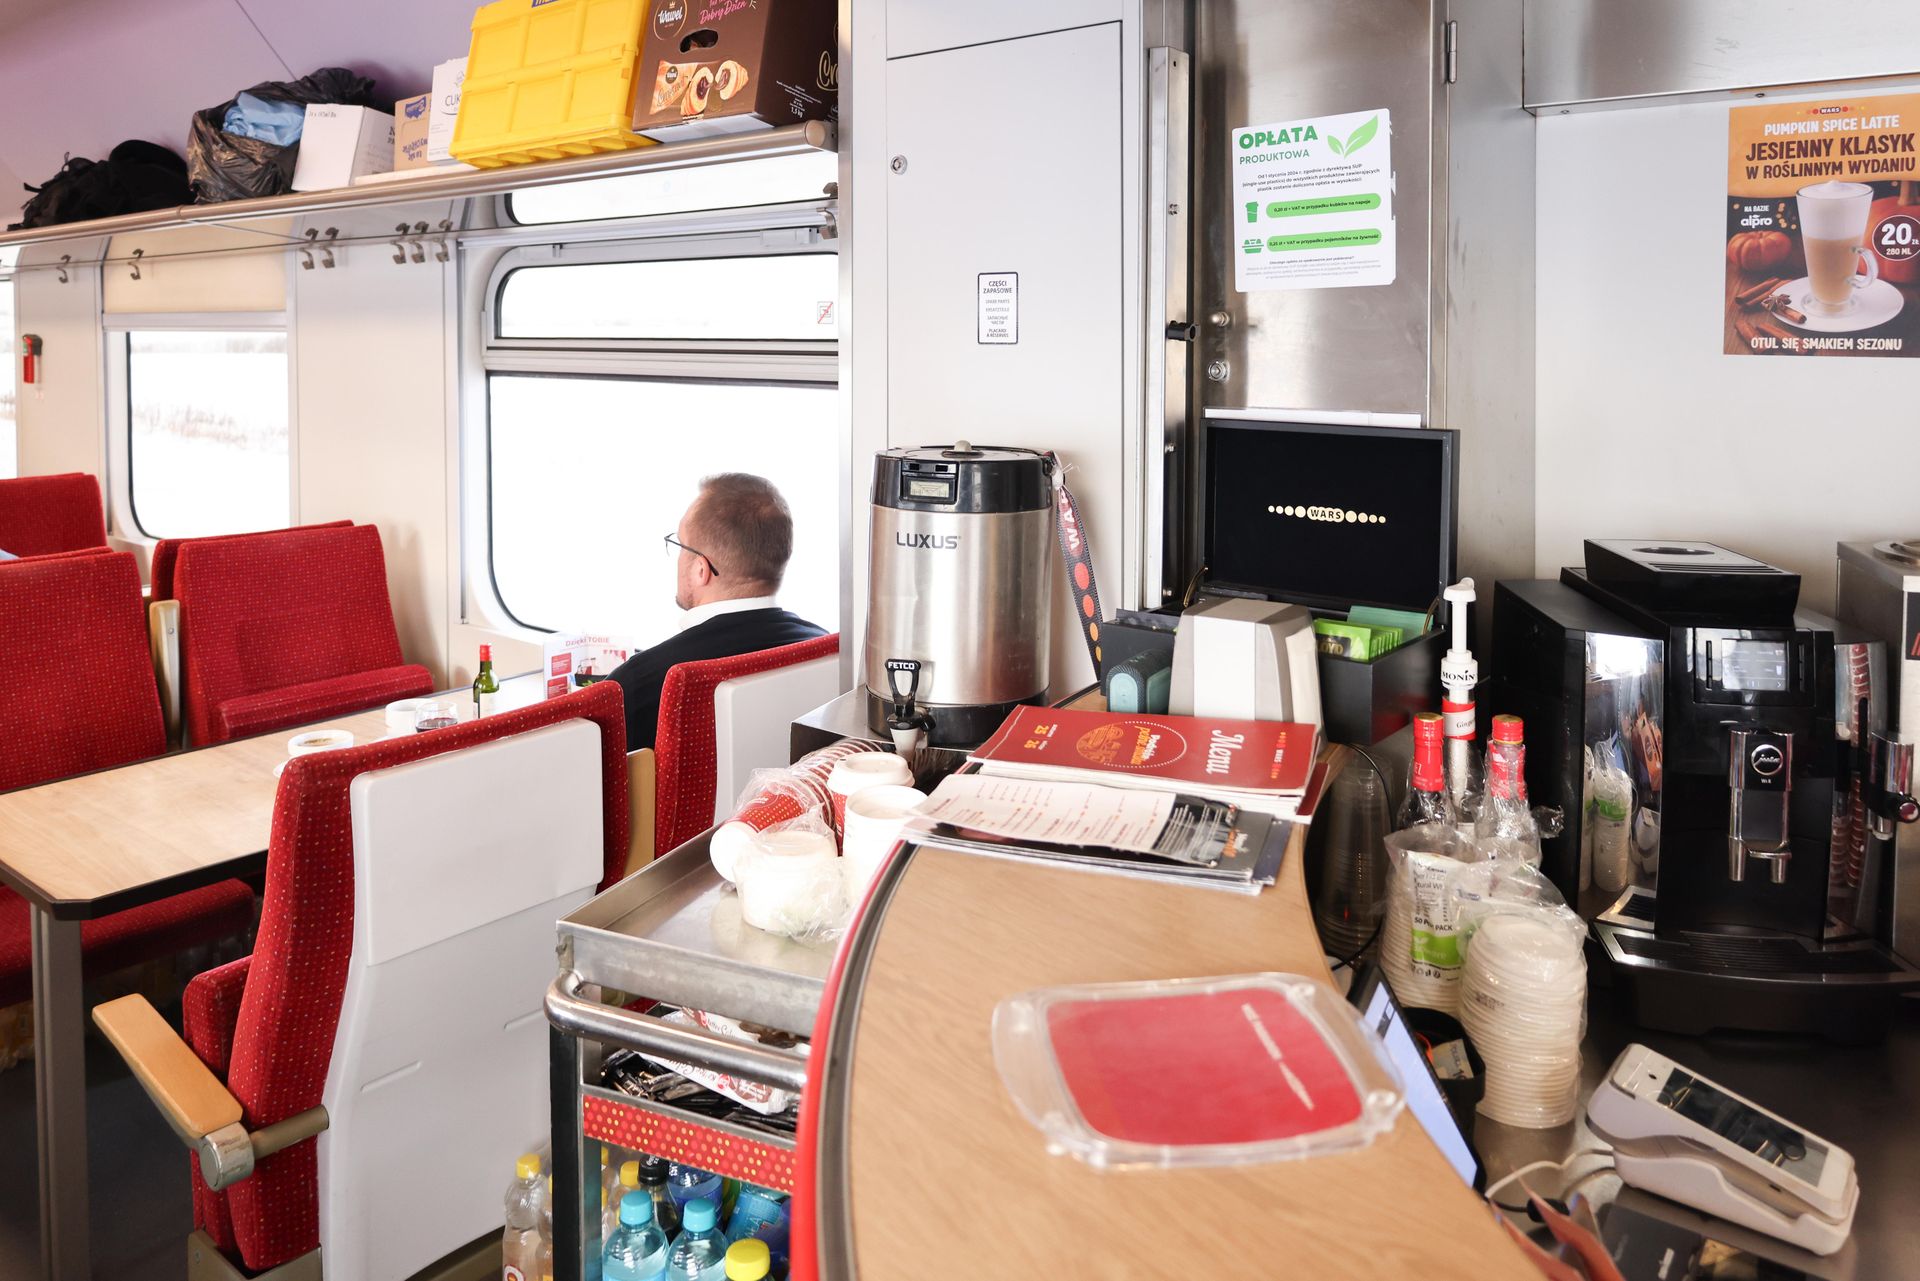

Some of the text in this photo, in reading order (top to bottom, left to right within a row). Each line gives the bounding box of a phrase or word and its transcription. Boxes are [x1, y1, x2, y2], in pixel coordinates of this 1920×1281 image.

[1764, 114, 1900, 136] PUMPKIN SPICE LATTE
[1239, 125, 1319, 150] OPŁATA
[1745, 133, 1915, 162] JESIENNY KLASYK
[1239, 149, 1310, 165] PRODUKTOWA
[1319, 172, 1344, 180] produktów
[1346, 168, 1380, 178] zawierających
[1326, 164, 1352, 172] dyrektywą
[1745, 156, 1916, 180] W ROŚLINNYM WYDANIU
[1740, 214, 1772, 229] alpro
[1881, 223, 1912, 245] 20
[1901, 246, 1912, 255] ML
[1751, 338, 1902, 352] OTUL SIĘ SMAKIEM SEZONU
[1310, 508, 1342, 520] WARS
[896, 532, 958, 550] LUXUS
[566, 638, 586, 647] Dzięki
[888, 662, 914, 670] FETCO
[1442, 670, 1476, 681] MONIN
[1205, 730, 1244, 775] Menu
[1435, 922, 1453, 932] PACK
